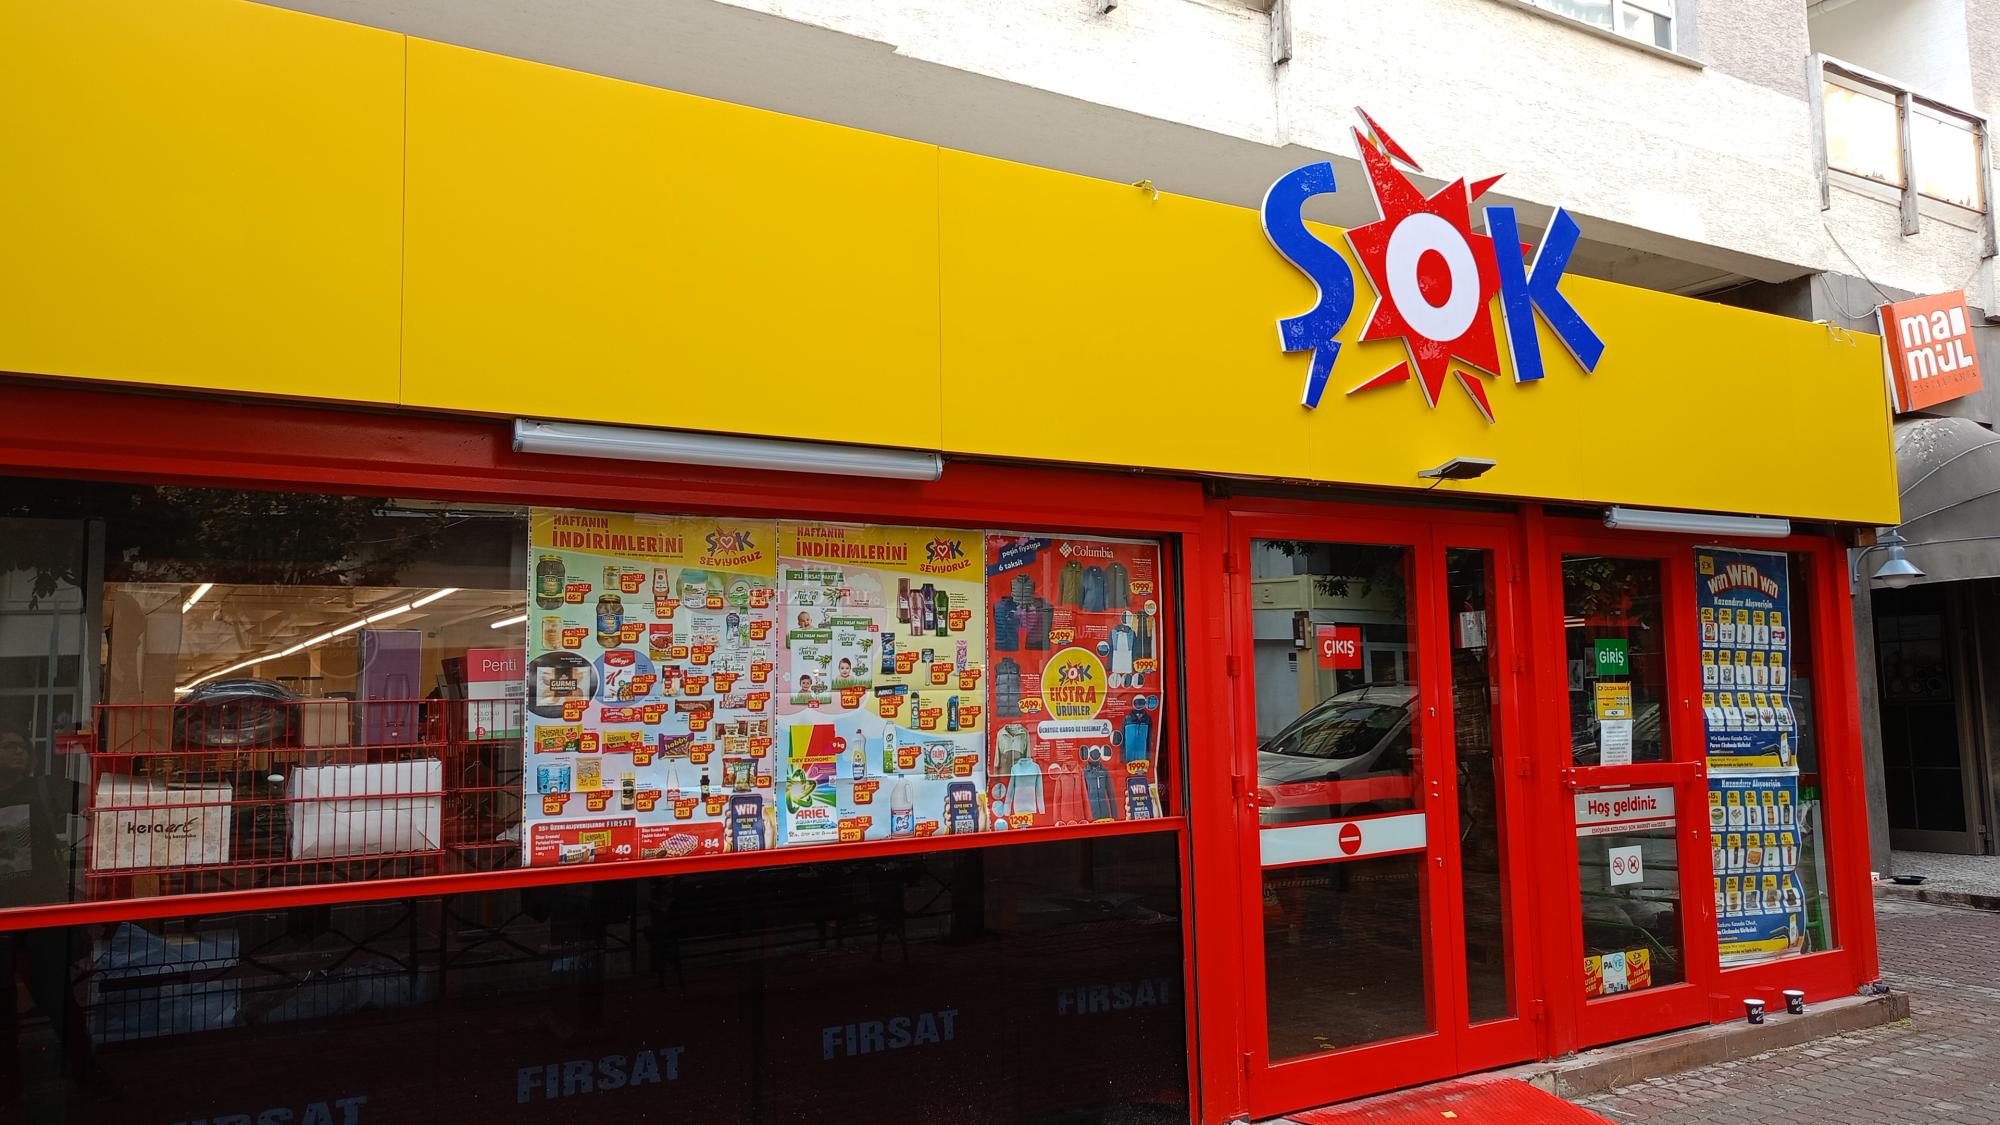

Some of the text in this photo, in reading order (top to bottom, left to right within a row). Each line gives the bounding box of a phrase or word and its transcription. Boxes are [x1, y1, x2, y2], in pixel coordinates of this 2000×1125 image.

[1260, 160, 1605, 408] ŞOK
[554, 514, 608, 529] HAFTANIN
[553, 527, 683, 553] İNDİRİMLERİNİ
[797, 527, 844, 538] HAFTANIN
[796, 537, 908, 560] İNDİRİMLERİNİ
[1072, 545, 1114, 559] Columbia
[998, 559, 1023, 571] 6 taksit
[1323, 639, 1355, 657] ÇIKIŞ
[1599, 647, 1625, 666] GİRİŞ
[482, 659, 516, 672] Penti
[1059, 663, 1092, 686] ŞOK
[551, 680, 576, 688] GURME
[1050, 686, 1097, 703] EKSTRA
[1056, 704, 1090, 717] ÜRÜNLER
[796, 808, 829, 819] ARIEL
[1588, 795, 1657, 817] Hoş geldiniz
[607, 820, 632, 828] FIRSAT
[1057, 977, 1172, 1017] FIRSAT
[822, 1008, 958, 1060] FIRSAT
[516, 1045, 686, 1103] FIRSAT
